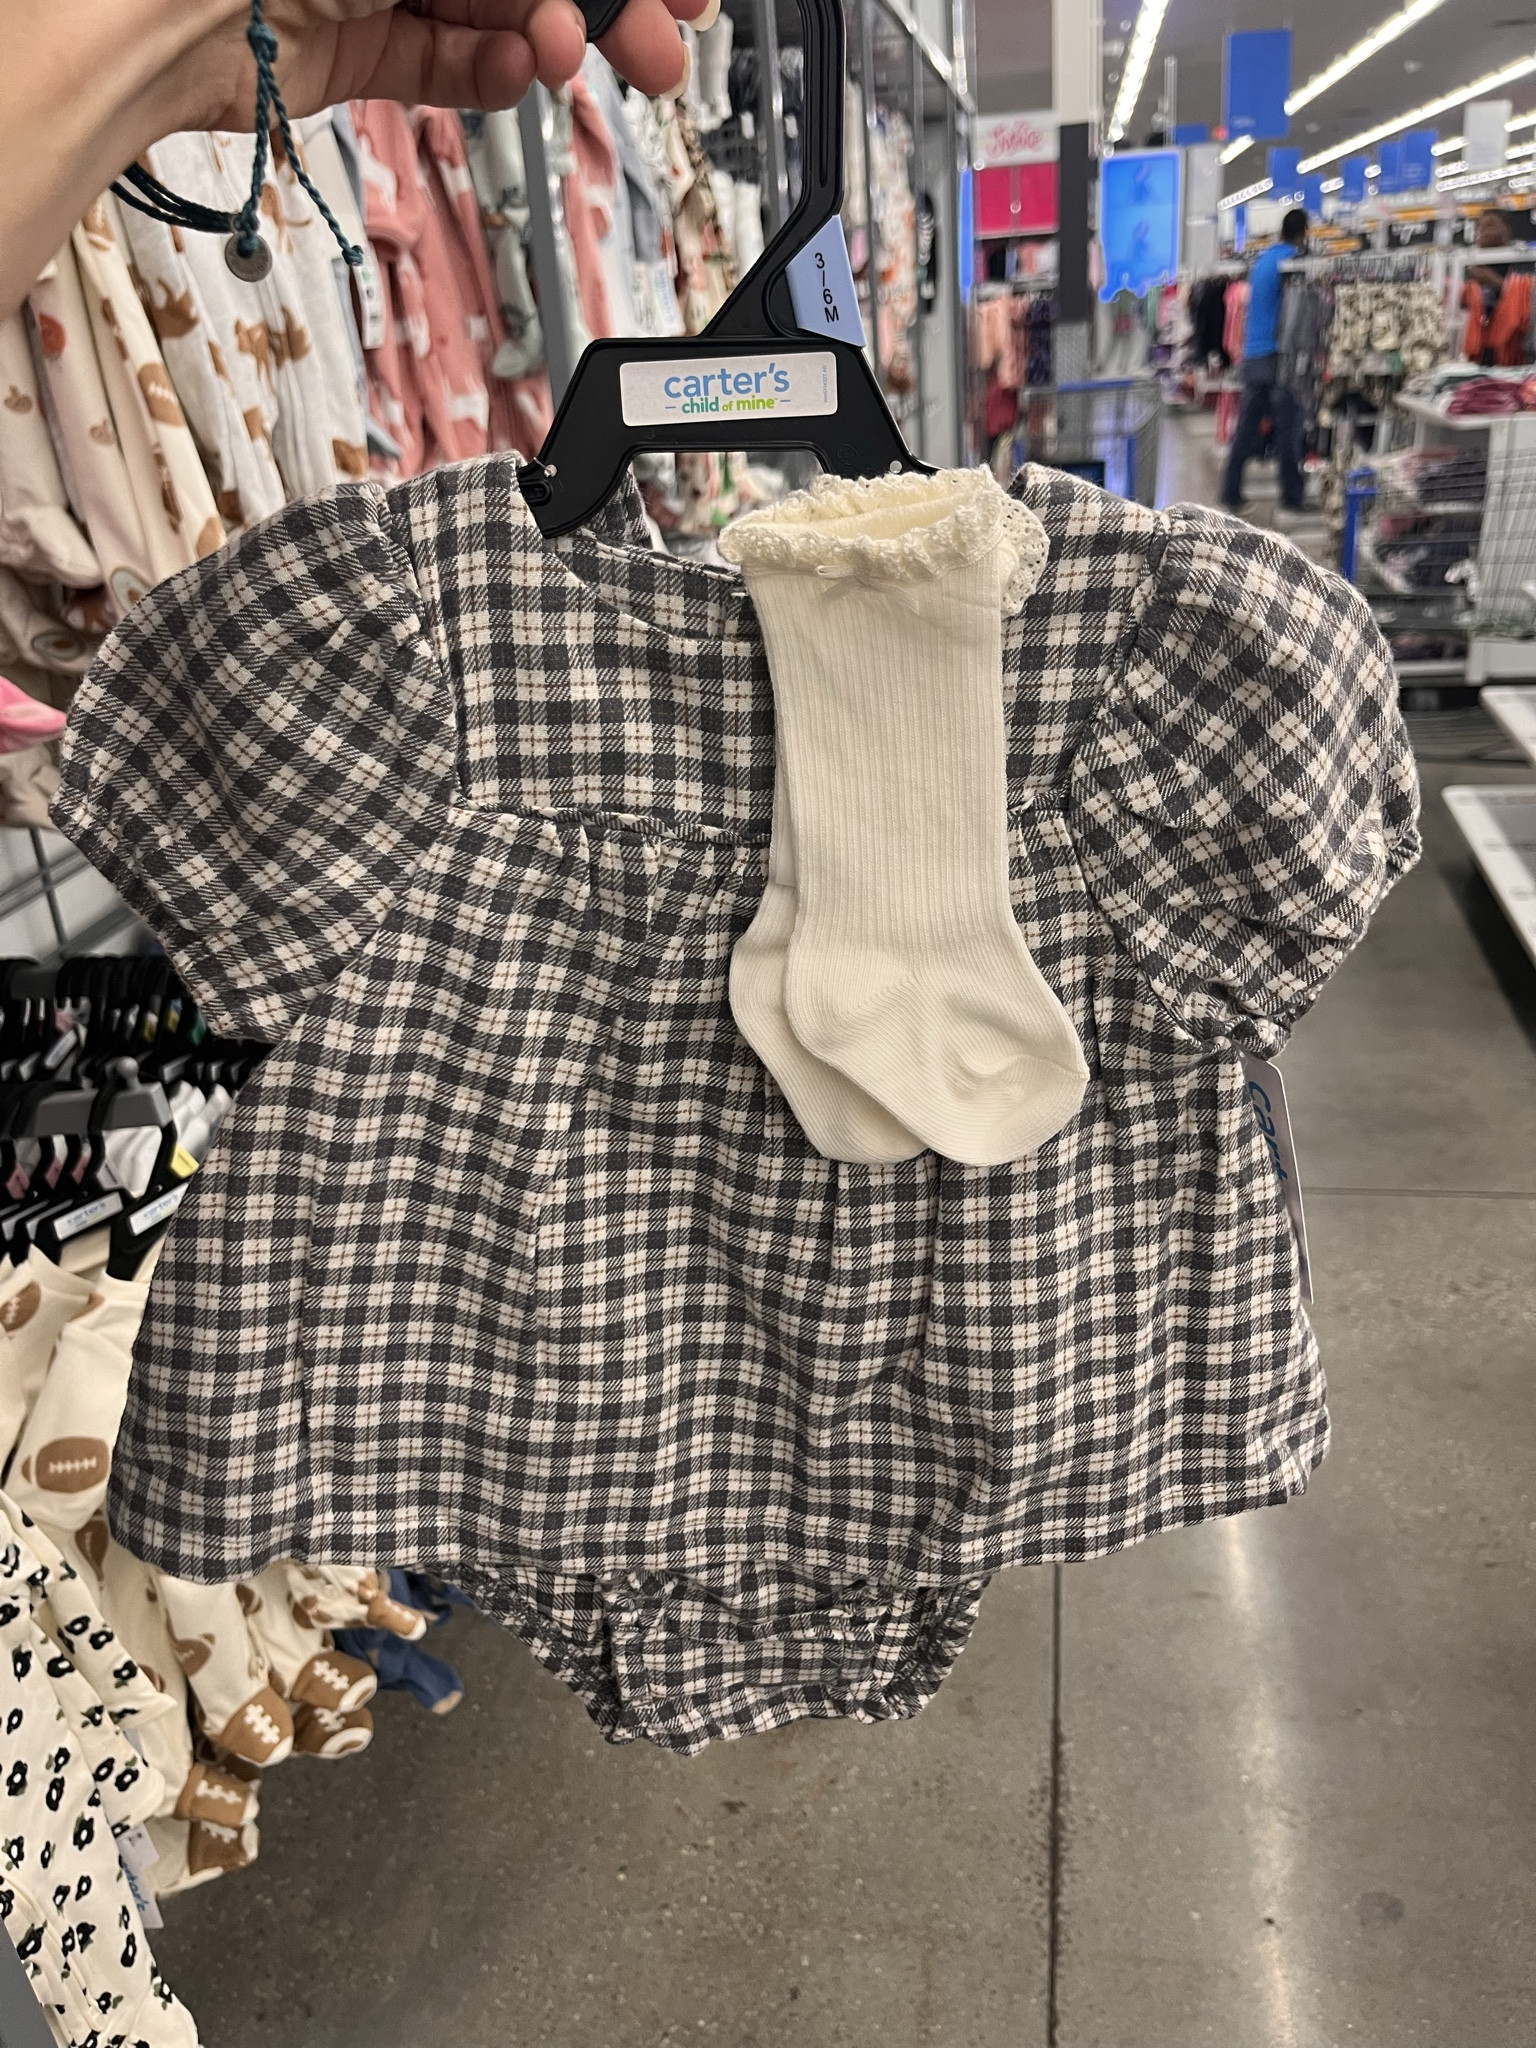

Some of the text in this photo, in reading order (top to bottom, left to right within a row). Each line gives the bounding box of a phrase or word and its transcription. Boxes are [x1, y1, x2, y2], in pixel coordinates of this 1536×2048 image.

[664, 362, 790, 399] carter's
[682, 395, 775, 414] child of mine
